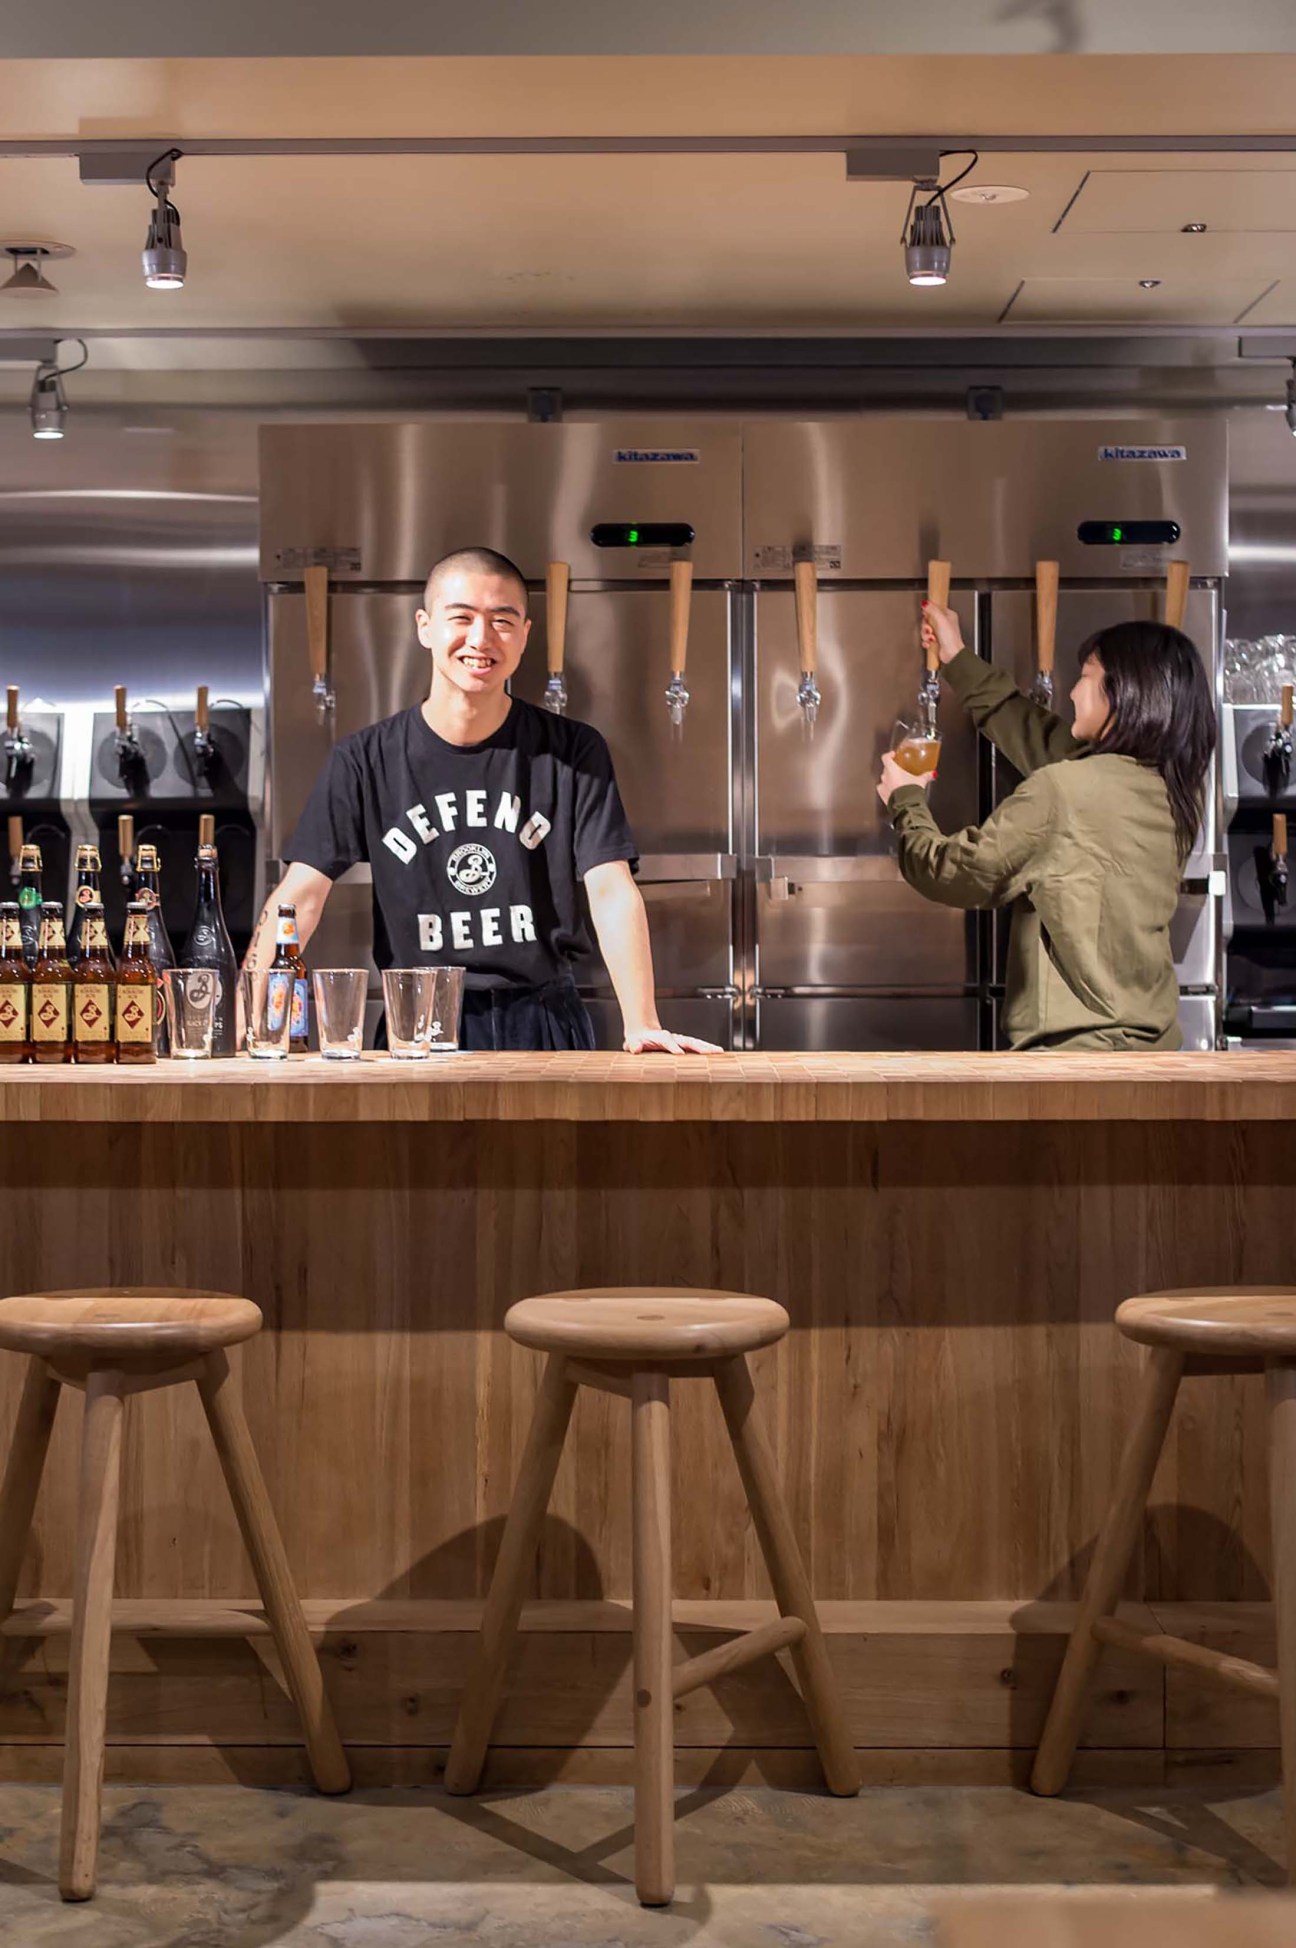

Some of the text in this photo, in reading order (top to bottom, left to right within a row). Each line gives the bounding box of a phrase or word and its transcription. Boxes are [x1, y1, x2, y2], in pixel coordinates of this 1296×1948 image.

[616, 450, 697, 462] kitazawa
[1103, 447, 1182, 460] kitazawa
[382, 789, 552, 865] DEFEND
[417, 904, 537, 951] BEER
